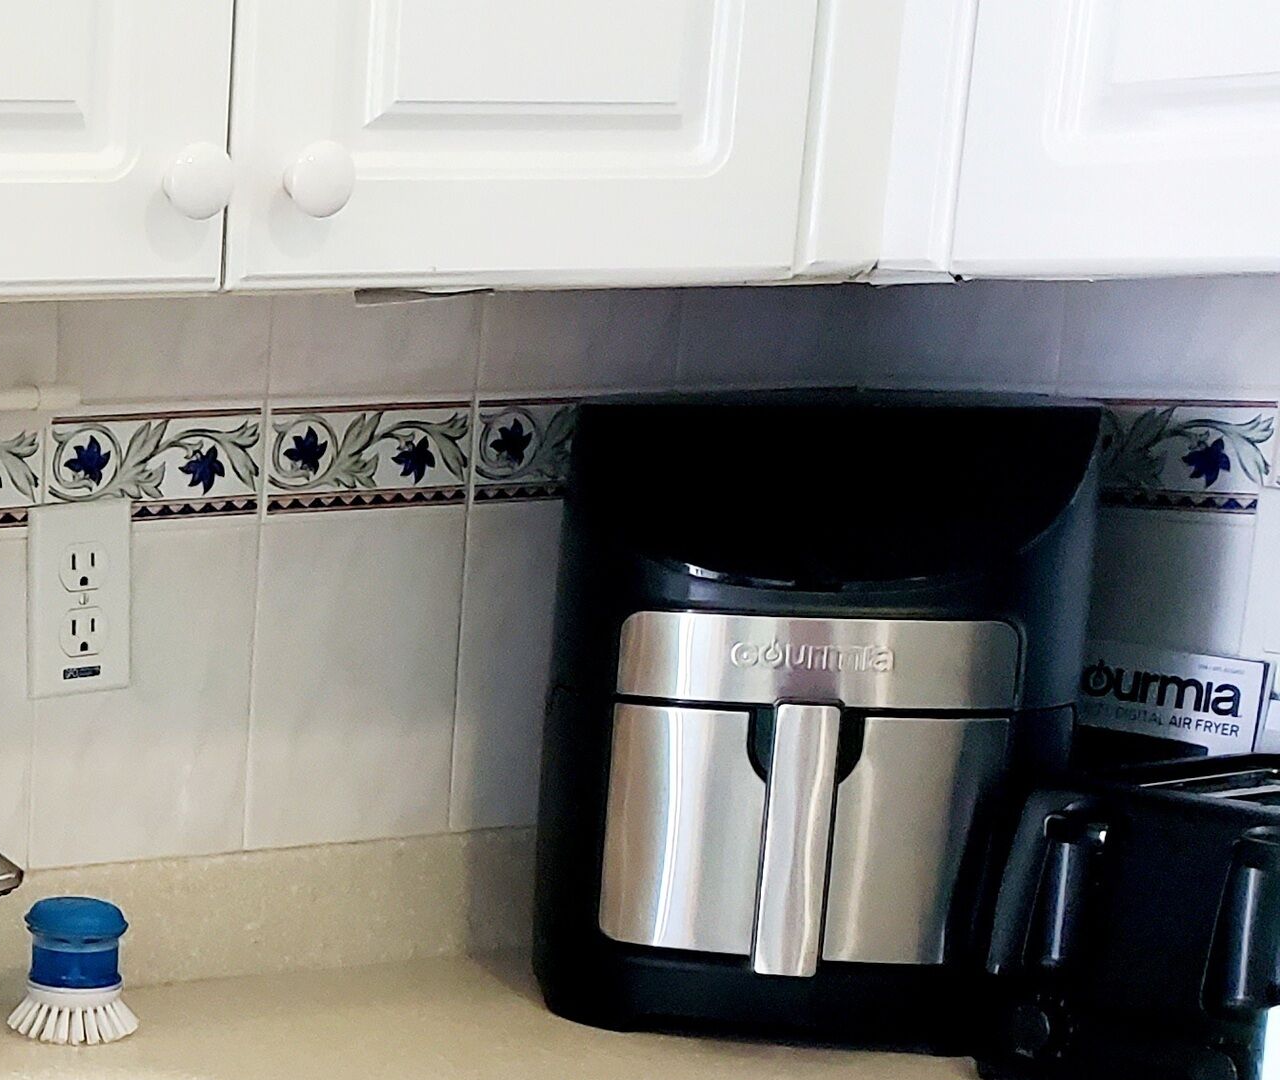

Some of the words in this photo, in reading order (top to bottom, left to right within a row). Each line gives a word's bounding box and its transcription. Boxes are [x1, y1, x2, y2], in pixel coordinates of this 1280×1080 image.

[1082, 659, 1242, 718] ourmia
[1168, 714, 1193, 730] AIR
[1194, 718, 1240, 737] FRYER
